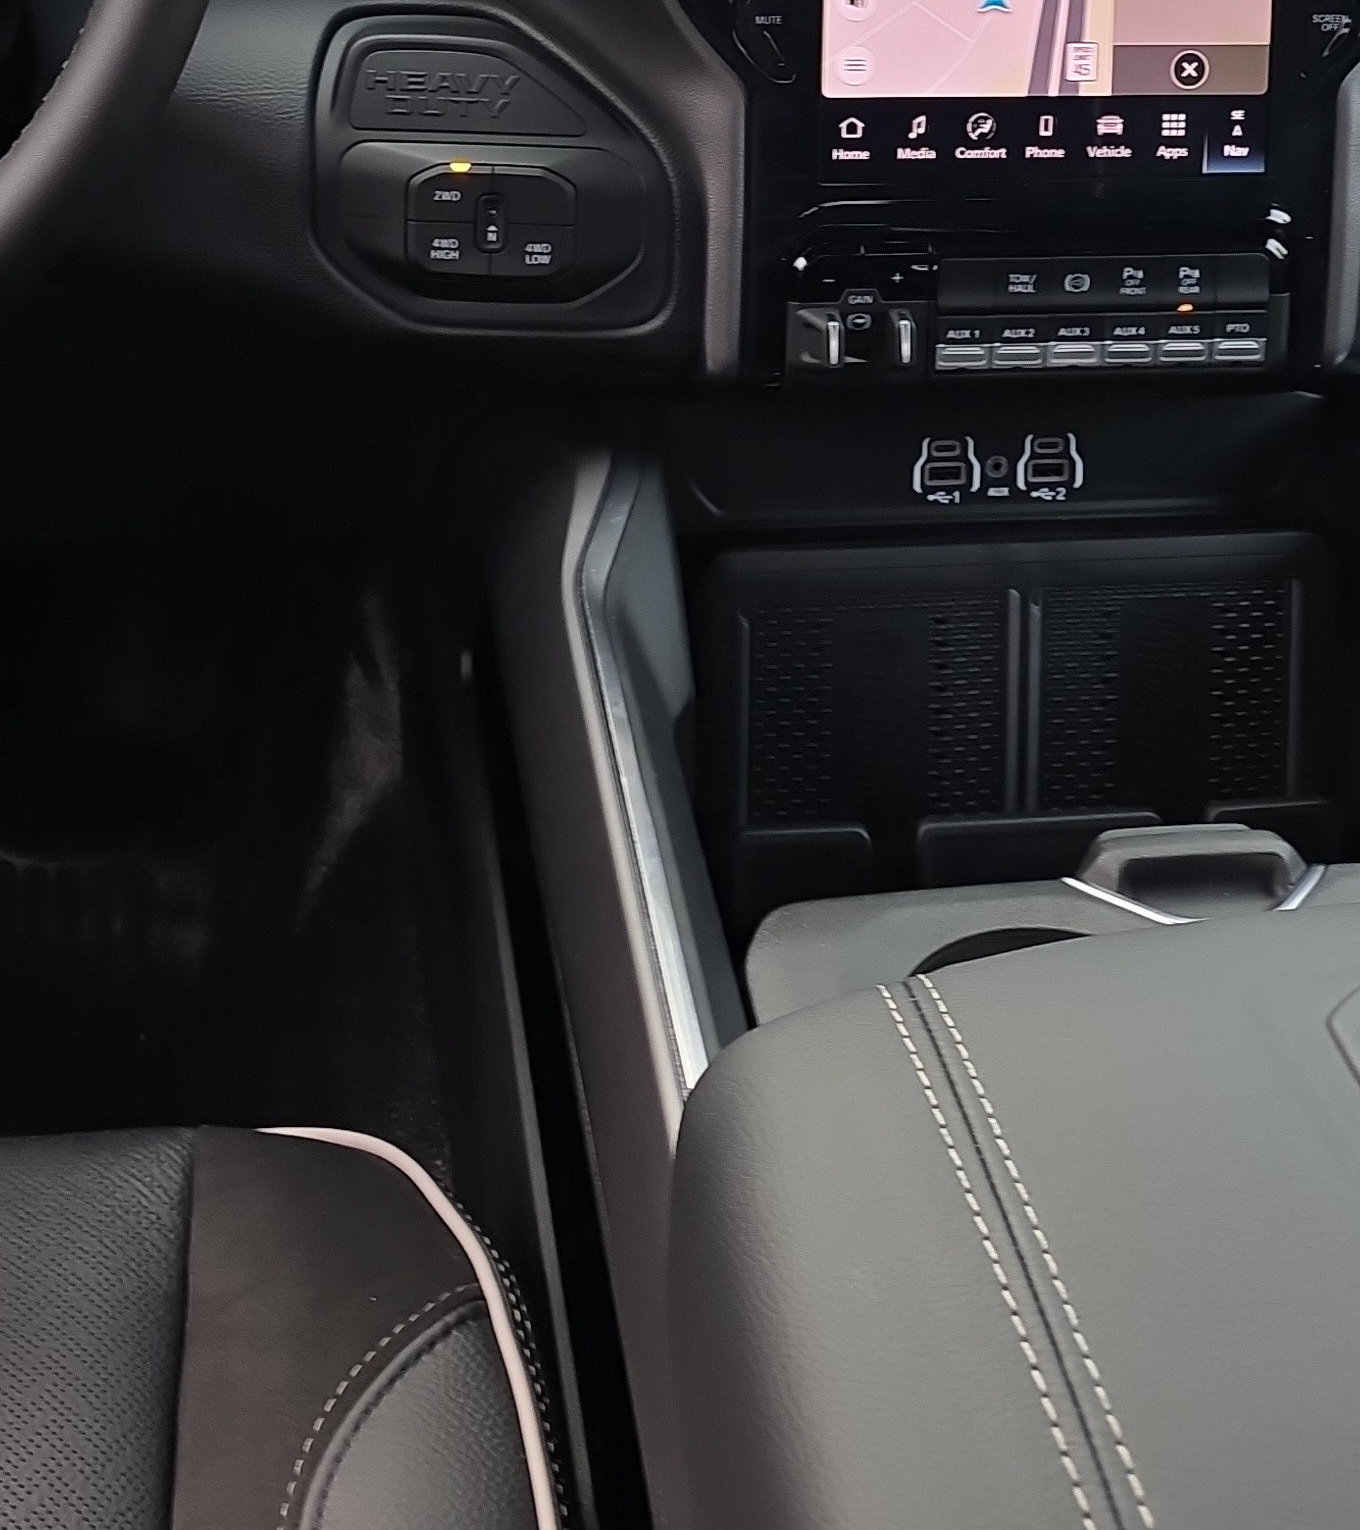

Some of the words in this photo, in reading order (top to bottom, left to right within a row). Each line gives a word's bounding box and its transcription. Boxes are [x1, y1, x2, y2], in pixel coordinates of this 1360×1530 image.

[754, 15, 783, 25] MUTE
[1311, 13, 1351, 24] SCREEN
[1320, 23, 1340, 32] OFF
[365, 68, 521, 96] HEAVY
[384, 94, 512, 119] DUTY
[831, 148, 871, 160] Home
[896, 147, 937, 160] Media
[954, 146, 1008, 160] Comfort
[1024, 146, 1066, 159] Phone
[1086, 145, 1133, 158] Vehicle
[1155, 145, 1189, 160] Apps
[1223, 144, 1250, 157] Nav
[432, 190, 462, 202] 2WD
[486, 232, 498, 242] N
[431, 238, 460, 249] 4WD
[524, 243, 553, 254] 4WD
[429, 249, 460, 261] HIGH
[524, 254, 552, 266] LOW
[1007, 284, 1037, 294] HAUL
[1119, 286, 1148, 296] FRONT
[1177, 285, 1201, 295] REAR
[846, 294, 874, 305] GAIN
[1225, 323, 1251, 334] PTO
[953, 490, 961, 504] 1
[1055, 487, 1067, 501] 2
